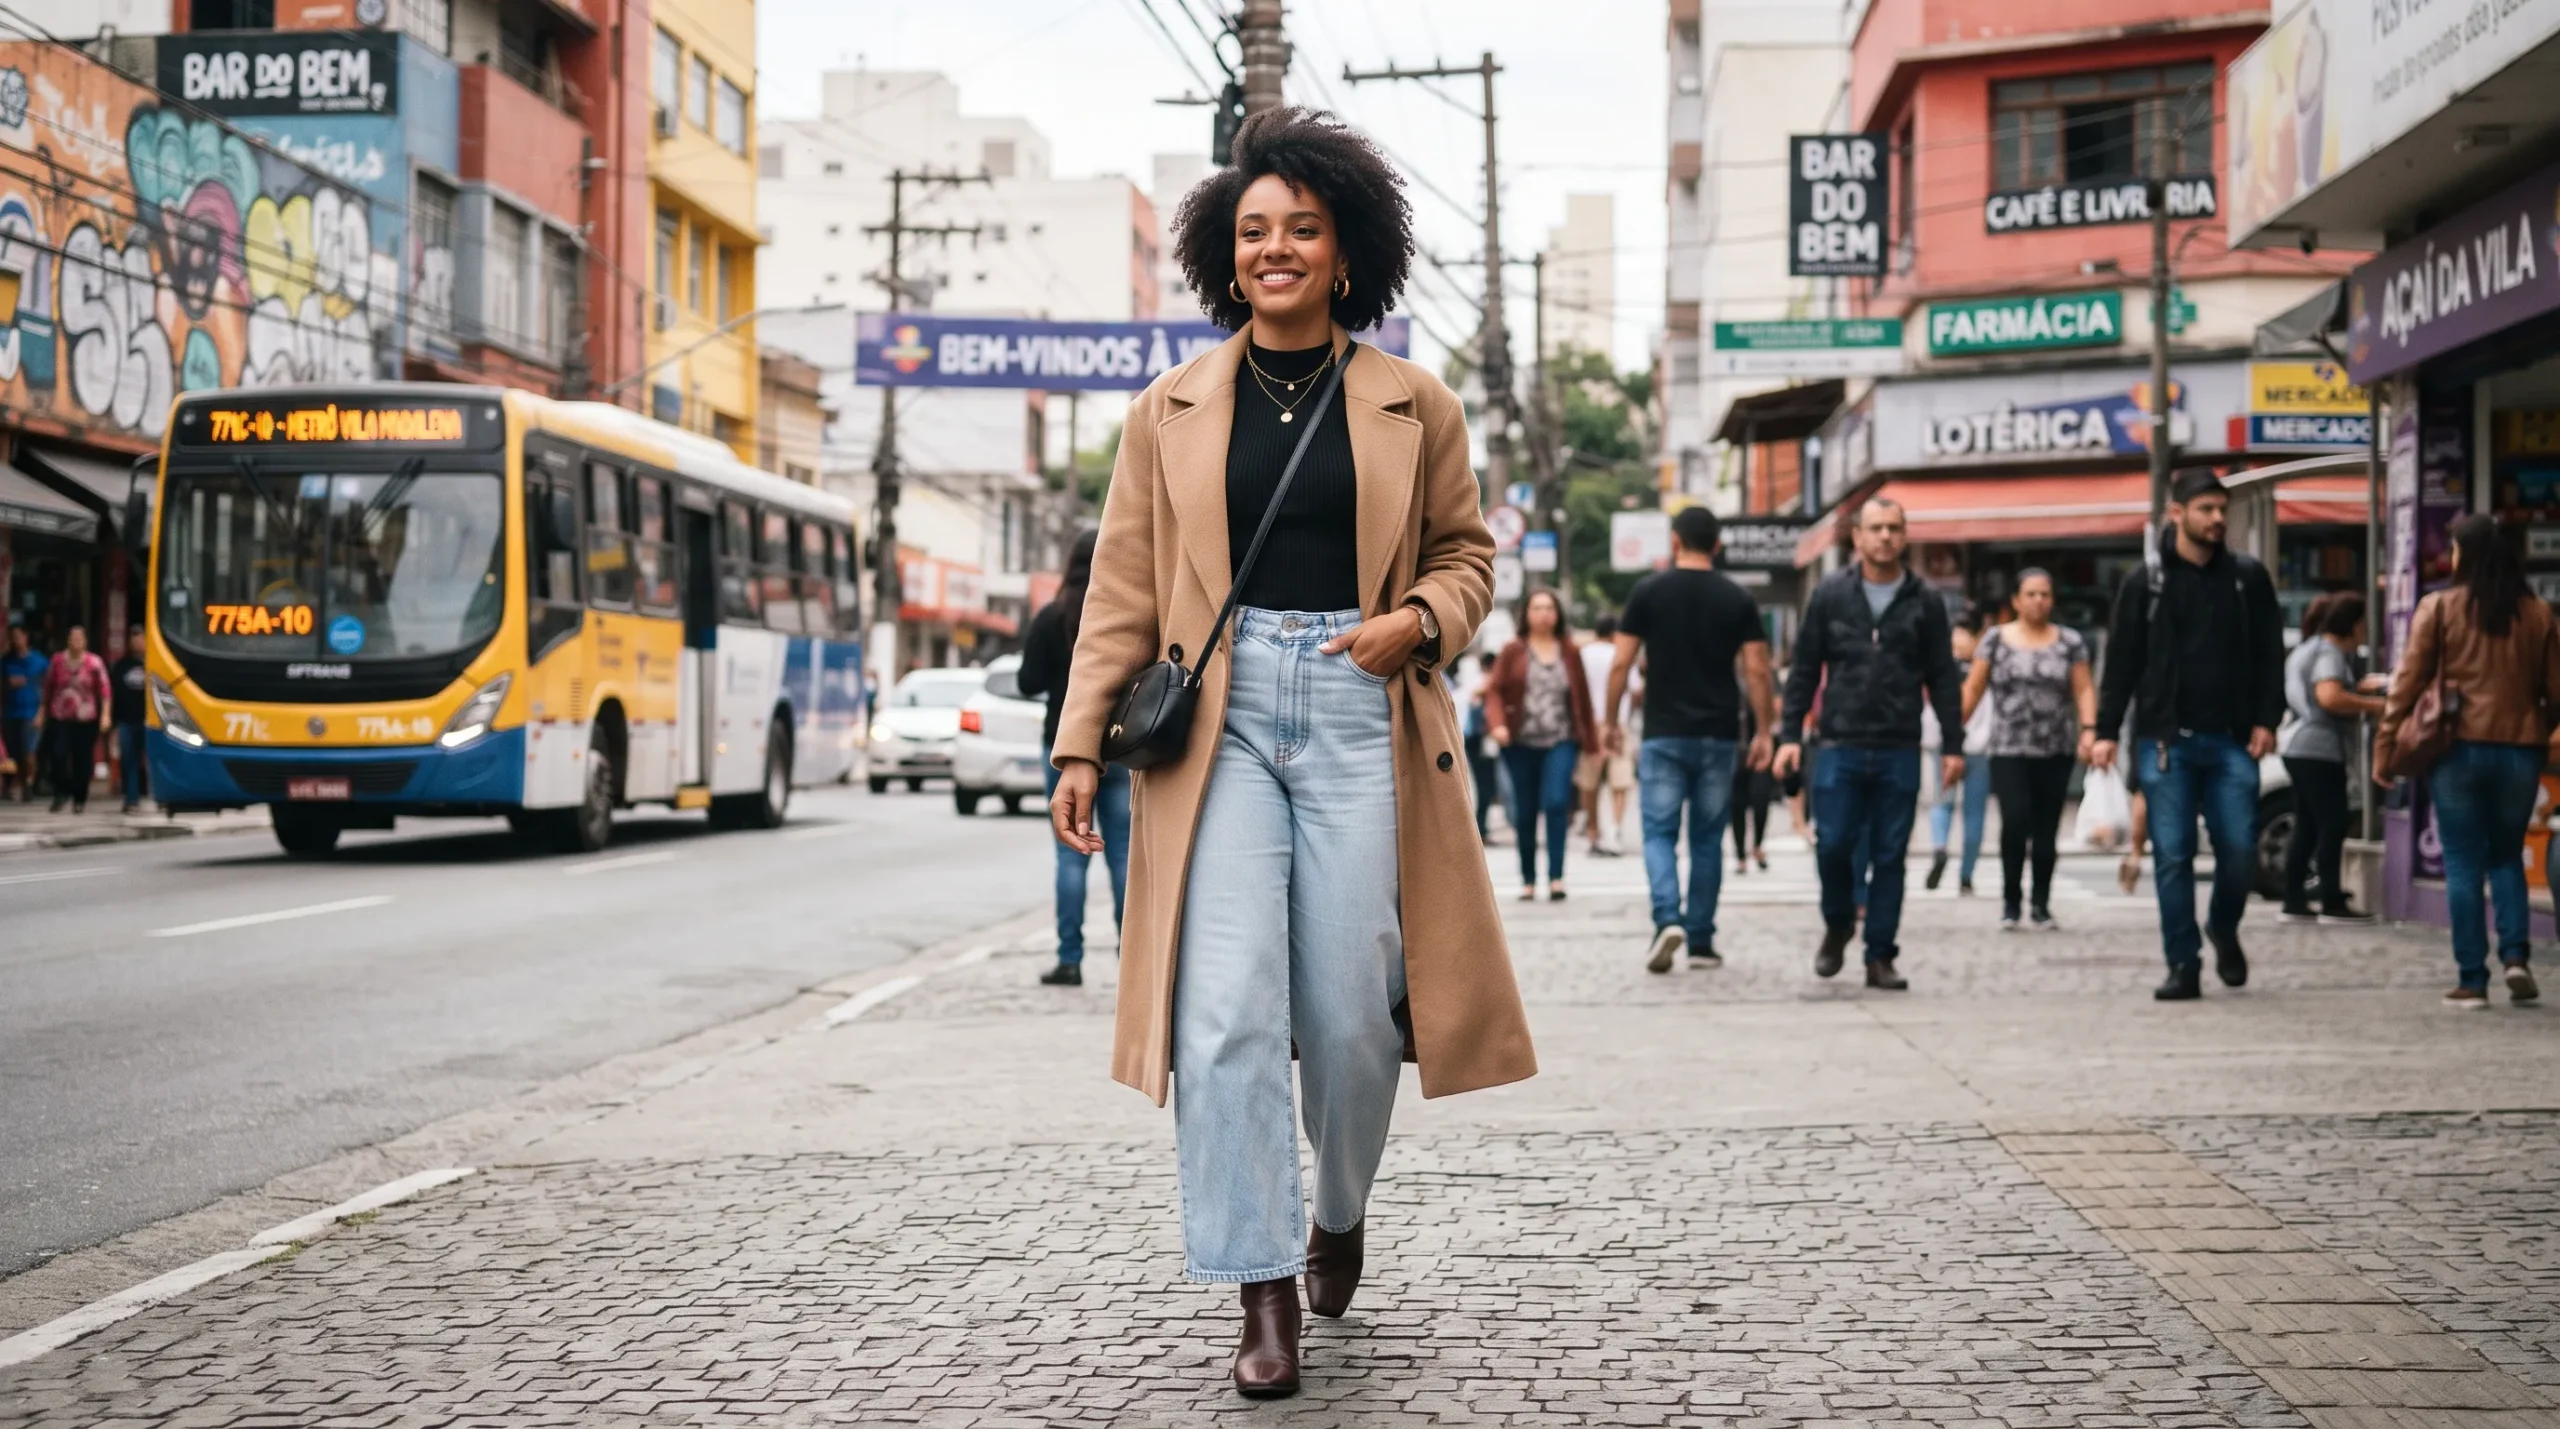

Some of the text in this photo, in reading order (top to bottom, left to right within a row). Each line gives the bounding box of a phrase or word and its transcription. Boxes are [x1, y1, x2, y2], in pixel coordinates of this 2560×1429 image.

[183, 51, 250, 100] BAR
[254, 53, 295, 98] DO
[1801, 139, 1877, 181] BAR
[1811, 181, 1867, 223] DO
[1986, 180, 2216, 229] CAFÉ E LIVRRIA
[1798, 221, 1880, 263] BEM
[2380, 211, 2537, 348] AÇAÍ DA VILA
[1932, 298, 2114, 345] FARMÁCIA
[937, 333, 1143, 378] BEM-VINDOS
[1145, 327, 1173, 378] À
[1923, 402, 2112, 454] LOTÉRICA
[205, 605, 313, 635] 775A-10
